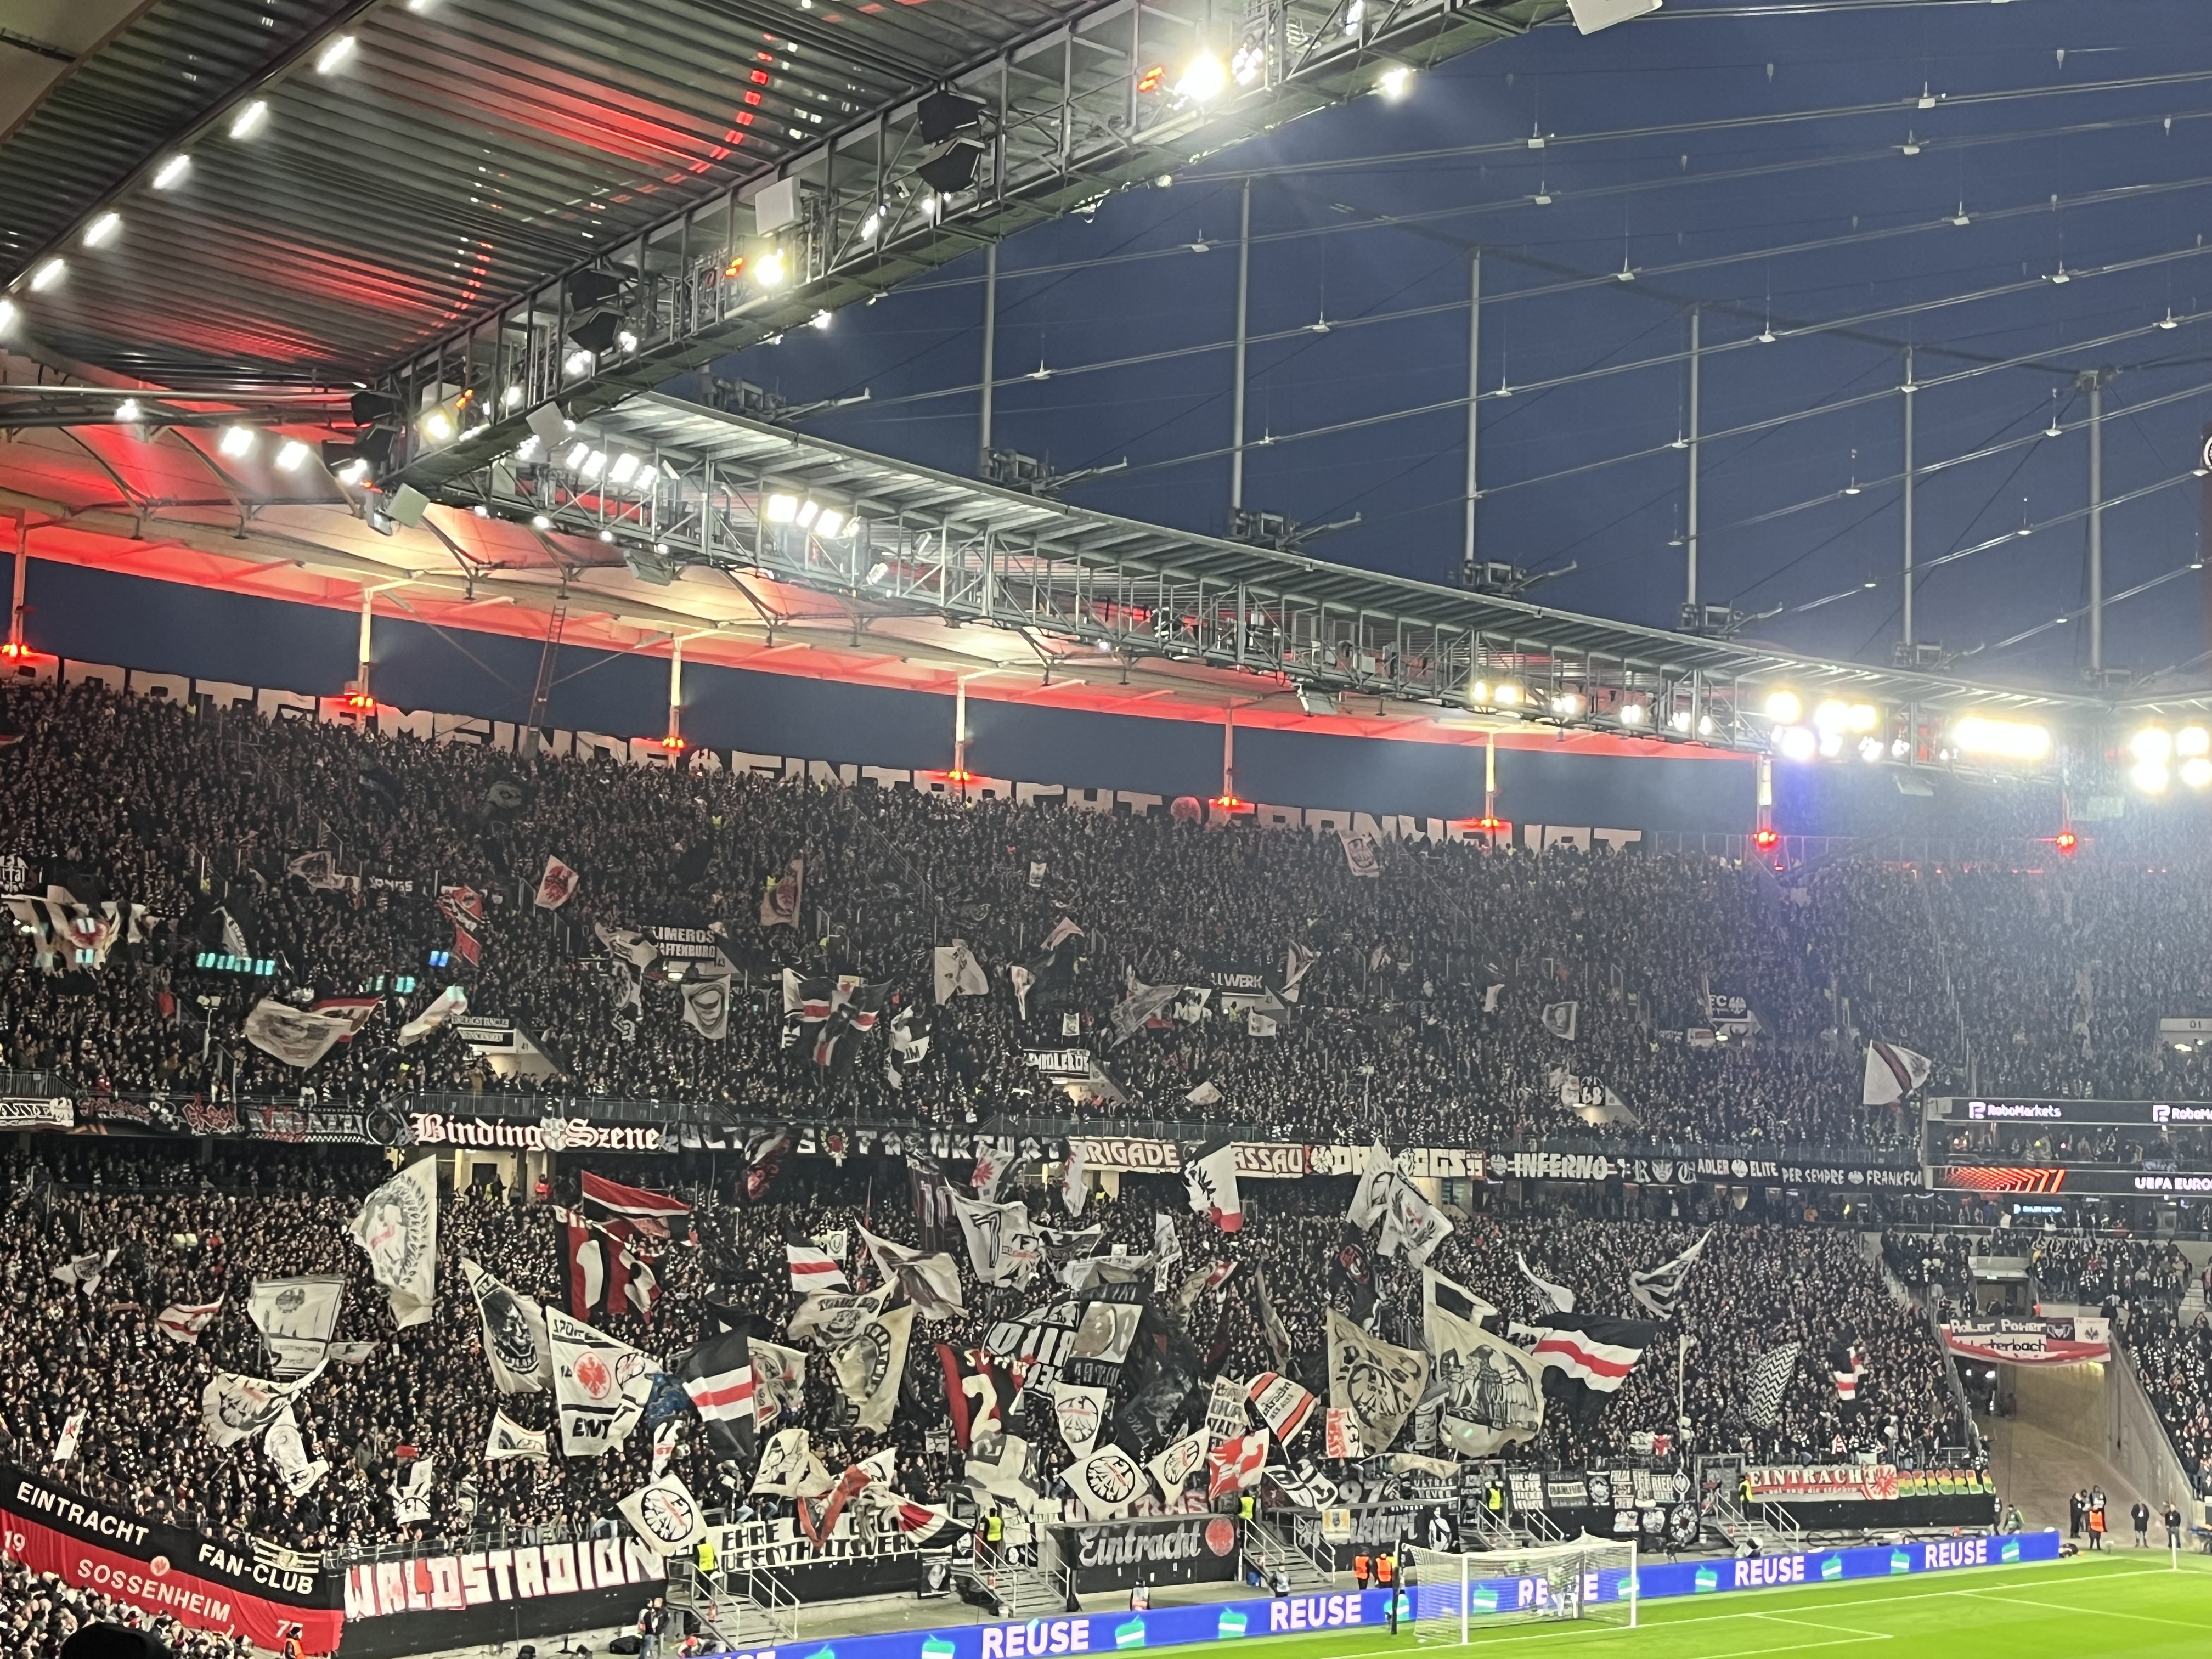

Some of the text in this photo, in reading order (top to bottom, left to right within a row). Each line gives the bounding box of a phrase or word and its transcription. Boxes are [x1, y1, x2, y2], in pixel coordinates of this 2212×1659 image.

[1987, 1104, 2062, 1118] RoboMarkets
[410, 1113, 661, 1151] Binding Szene
[1234, 1148, 1302, 1173] ASSAU
[1514, 1152, 1608, 1180] INFERNO
[1698, 1158, 1778, 1177] ADLER ELITE
[1782, 1167, 1802, 1183] PER
[1804, 1168, 1844, 1184] SEMPRE
[2135, 1177, 2212, 1191] UEFA EURO
[1750, 1468, 1877, 1487] EINTRACHT
[4, 1530, 26, 1553] 19
[16, 1481, 314, 1595] EINTRACHT FAN-CLUB
[1078, 1517, 1201, 1567] Eintracht
[1925, 1539, 1987, 1570] REUSE
[344, 1537, 666, 1620] WALDSTADION
[1735, 1555, 1805, 1587] REUSE
[77, 1559, 230, 1623] SOSSENHEIM
[1518, 1573, 1599, 1607] REE
[1270, 1594, 1362, 1631] REUSE
[983, 1620, 1090, 1659] REUSE
